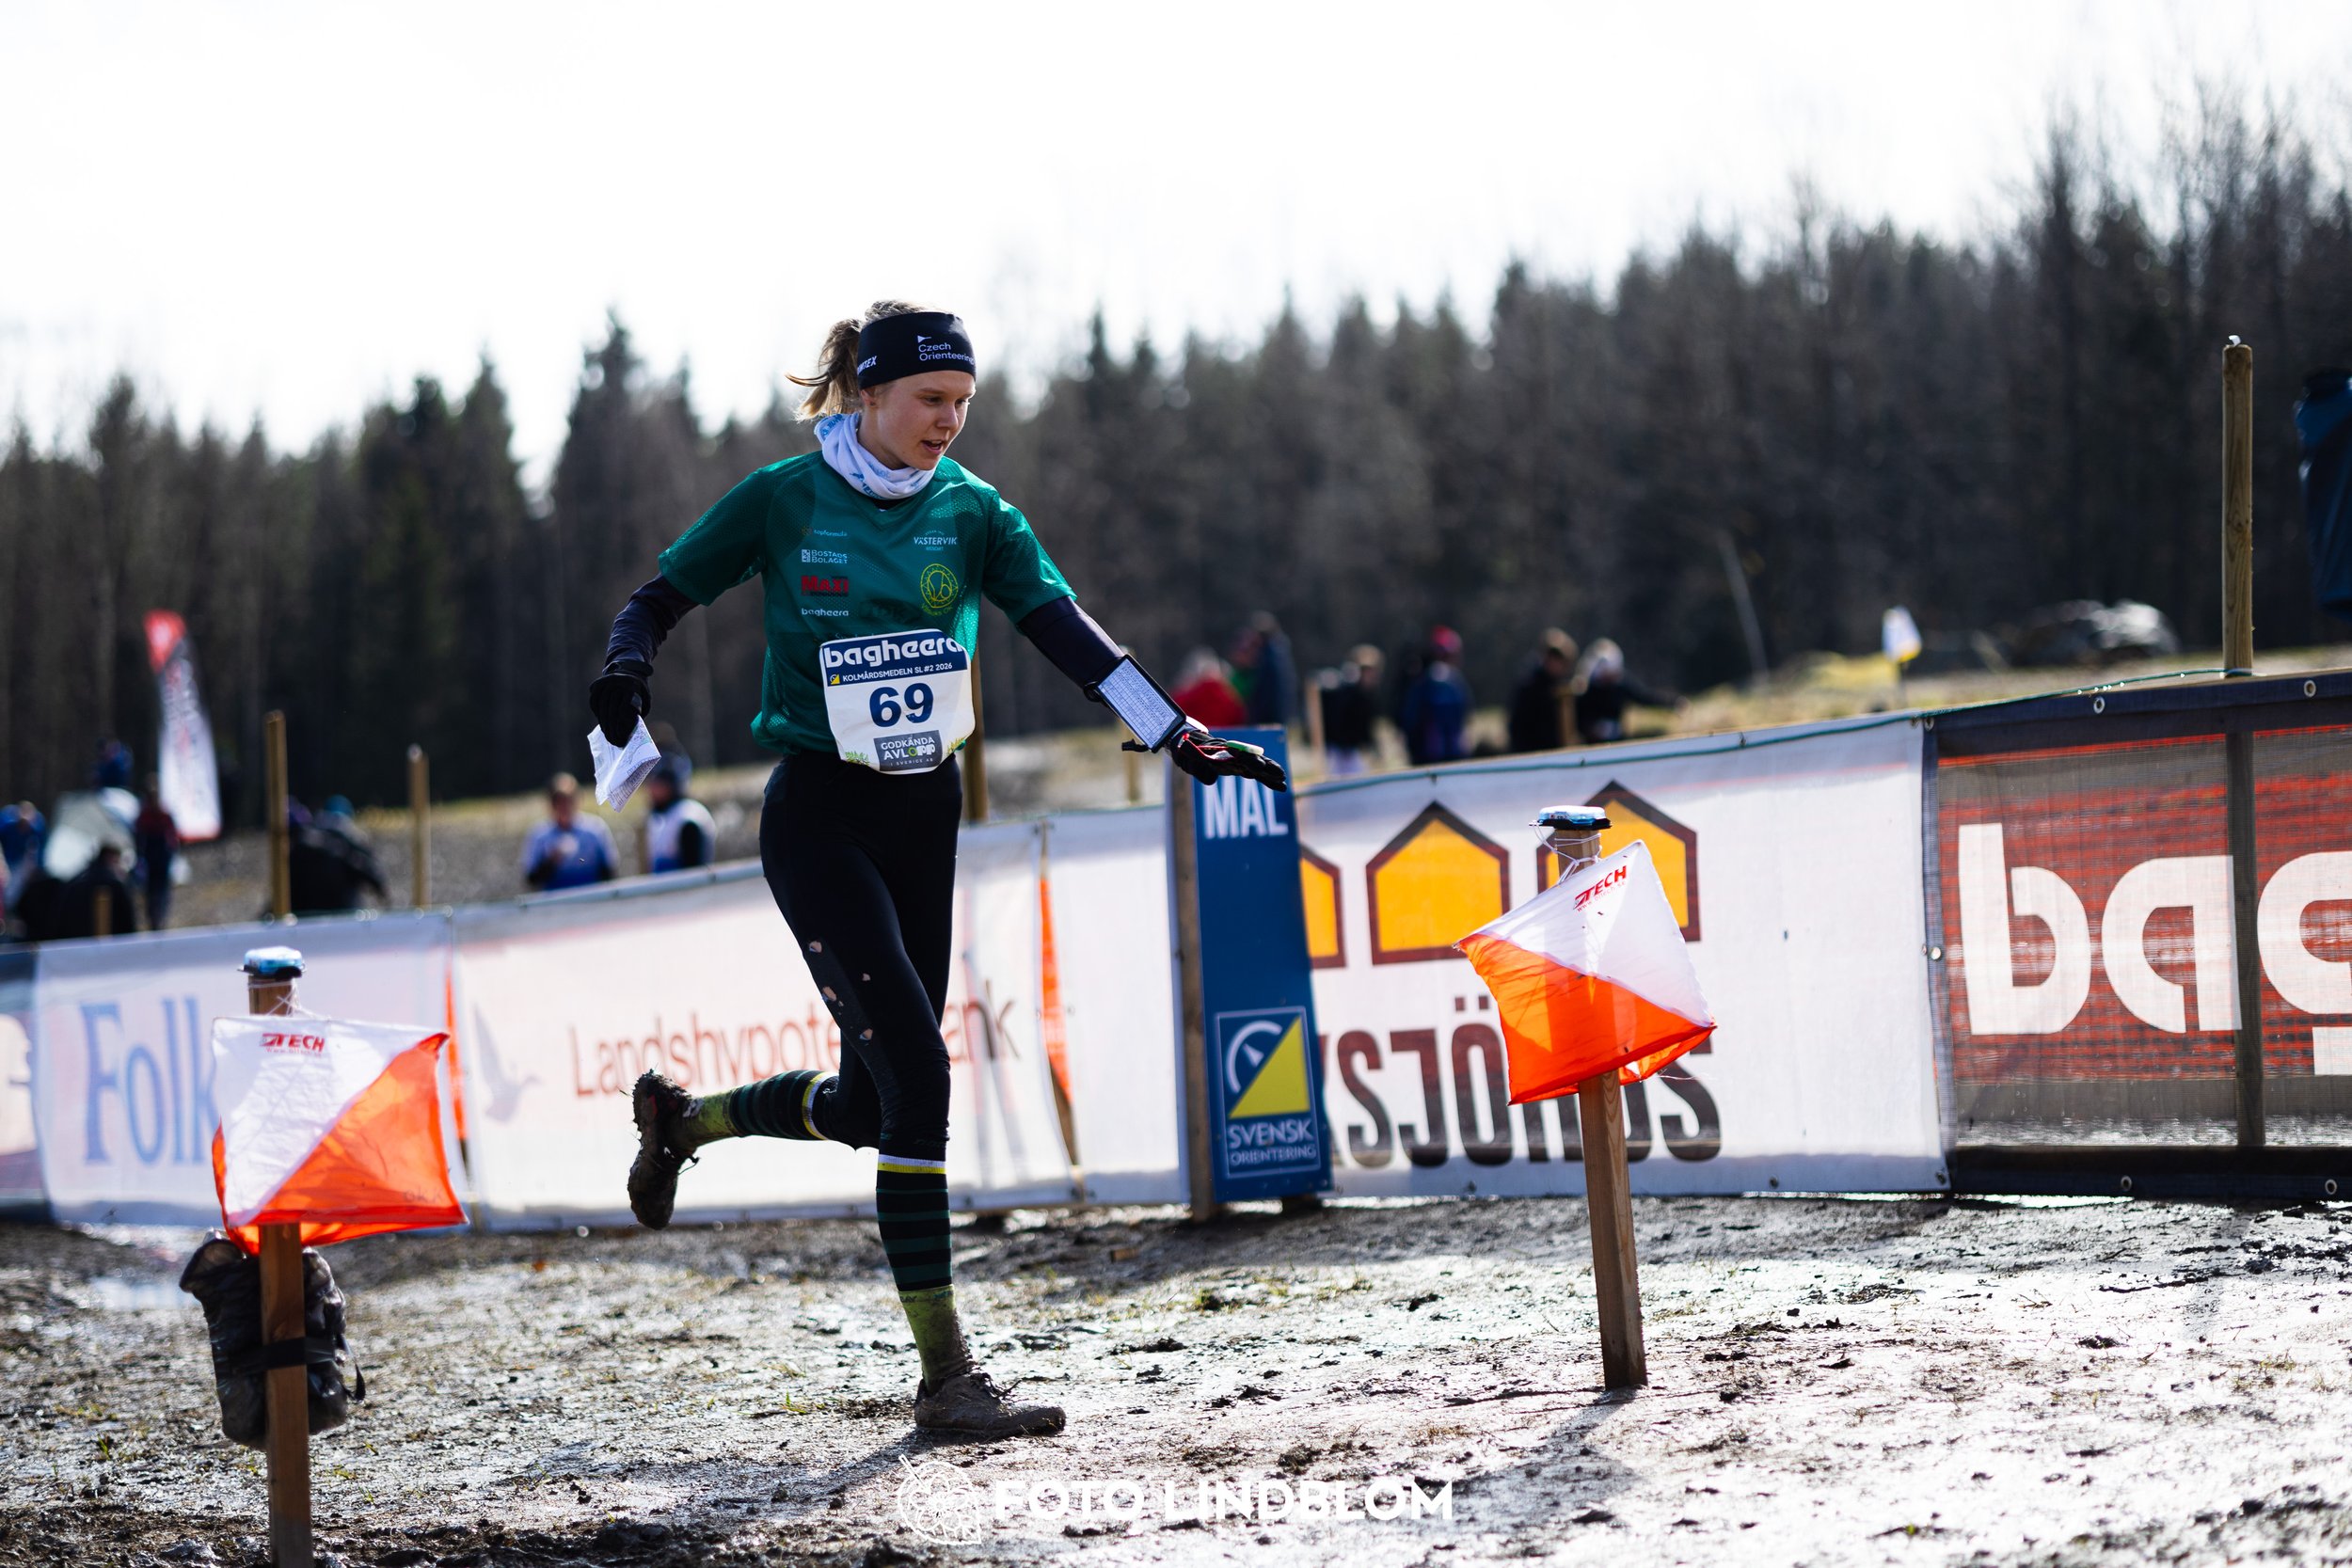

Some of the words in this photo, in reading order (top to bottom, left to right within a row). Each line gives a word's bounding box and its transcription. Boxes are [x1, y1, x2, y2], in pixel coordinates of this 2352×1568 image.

[918, 342, 951, 353] Czech
[919, 352, 975, 366] Orienteering
[914, 536, 958, 546] VÄSTERVIK
[802, 608, 850, 617] bagheera
[823, 637, 964, 669] bagheera
[843, 668, 914, 683] KOLMÅRDSMEDELN
[914, 665, 923, 674] SL
[924, 664, 934, 673] #2
[935, 662, 953, 672] 2026
[869, 683, 933, 728] 69
[881, 736, 935, 751] GODKÄNDA
[883, 743, 936, 761] AVLOPP
[896, 758, 923, 767] SVERIGE
[568, 1003, 841, 1098] Landshypote
[945, 981, 1021, 1064] ank
[1227, 1118, 1314, 1149] SVENSK
[1230, 1145, 1317, 1166] ORIENTERING
